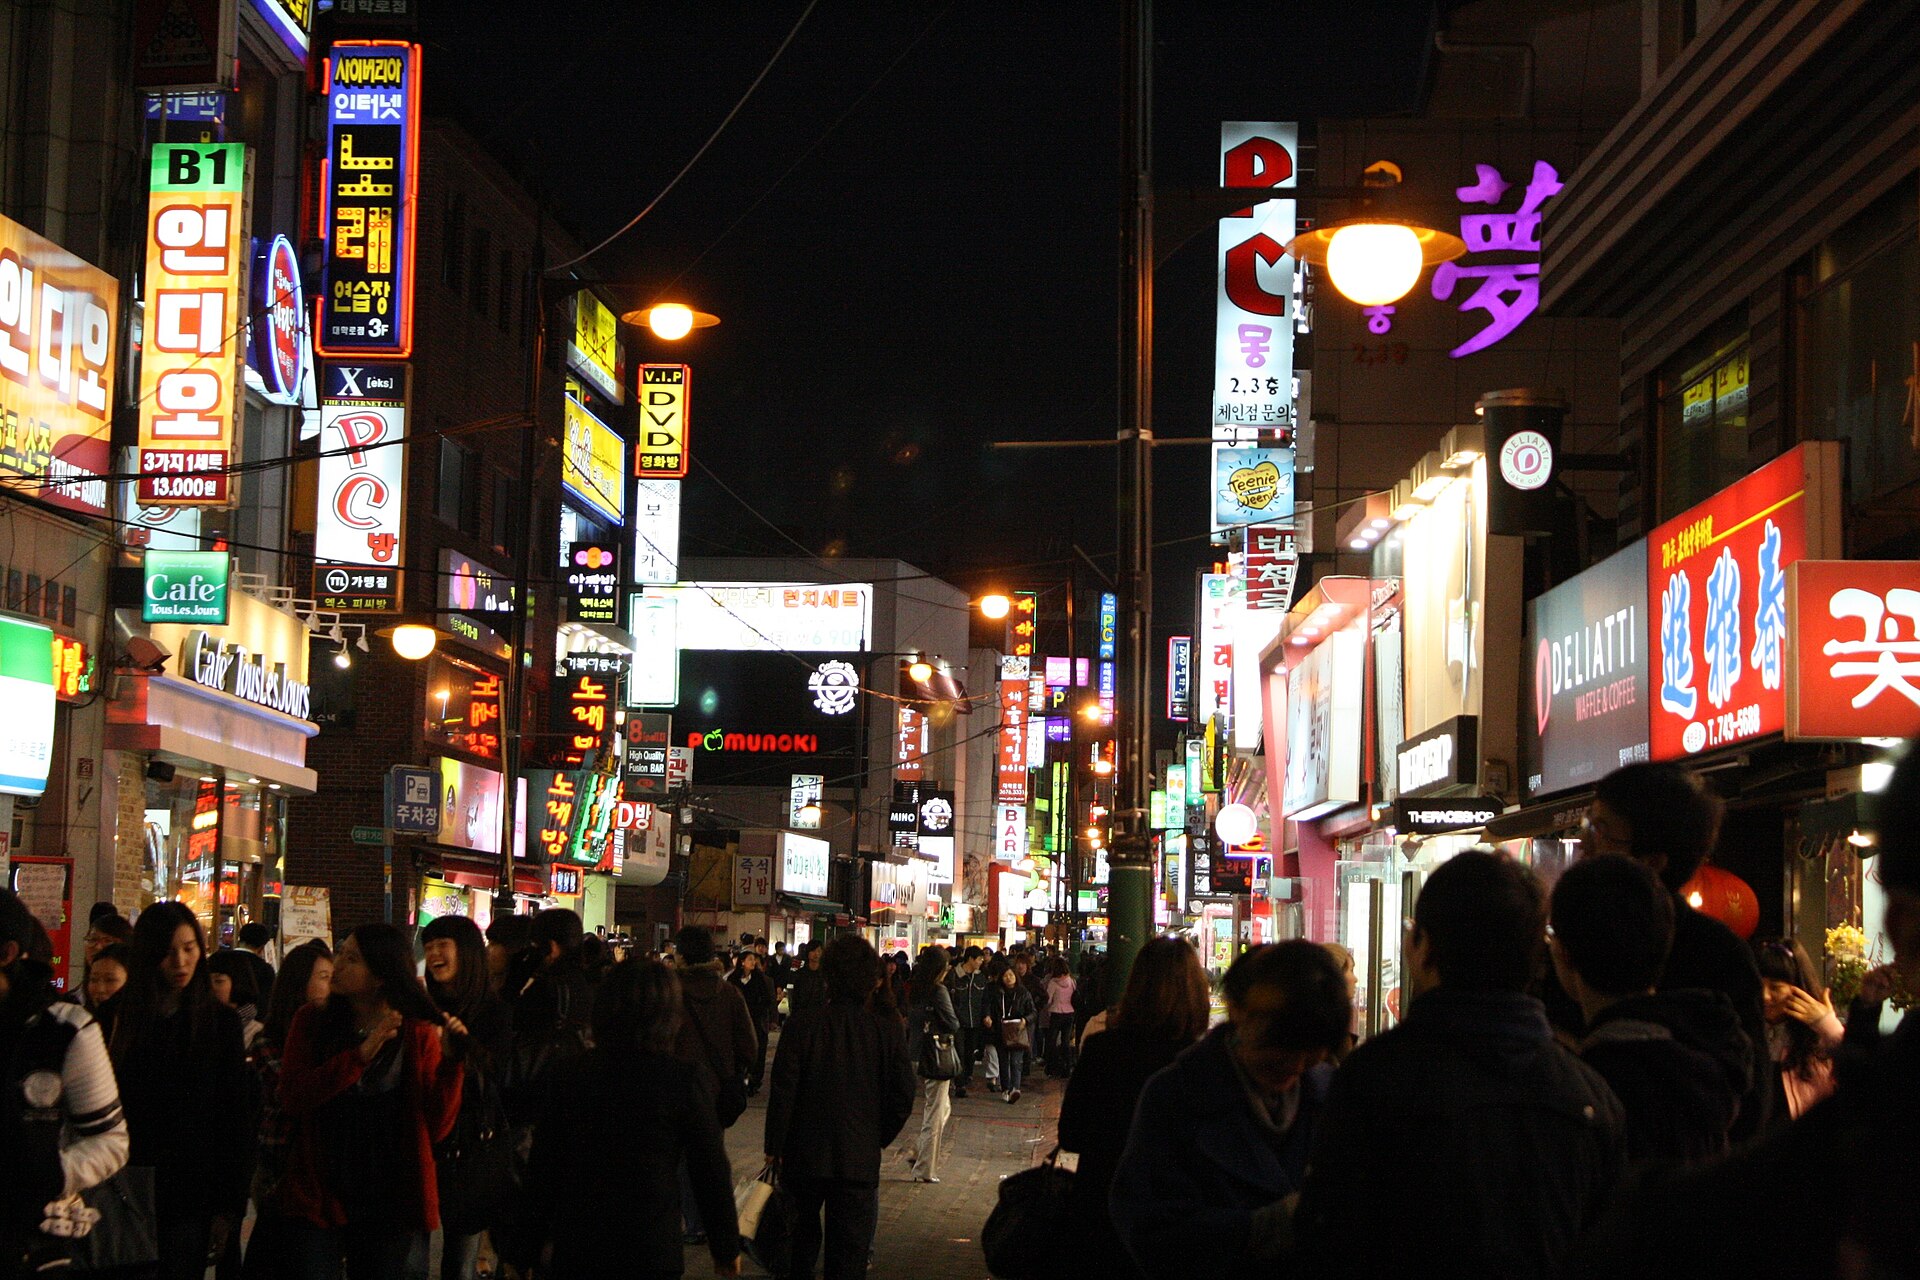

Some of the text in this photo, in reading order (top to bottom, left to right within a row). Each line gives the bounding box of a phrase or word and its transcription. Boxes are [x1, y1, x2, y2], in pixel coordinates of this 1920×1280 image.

[335, 93, 401, 119] 인터넷
[168, 148, 227, 185] B1
[336, 134, 393, 273] 노래
[1223, 136, 1293, 316] PC
[1431, 160, 1566, 358] 夢
[334, 281, 391, 314] 연습장
[149, 206, 232, 440] 인디오
[332, 318, 389, 337] 대학로점 3F
[1237, 323, 1273, 368] 몽
[337, 367, 364, 396] X
[645, 370, 681, 382] V.I.P
[647, 391, 675, 446] DVD
[1217, 402, 1291, 423] 체인점 문의
[1505, 435, 1549, 459] DELIATTI
[144, 453, 223, 474] 3가지 1세트
[327, 411, 389, 530] PC
[641, 457, 679, 468] 영화방
[152, 478, 217, 496] 13.000원
[1228, 472, 1276, 492] Teenie
[1237, 490, 1279, 507] Weenie
[367, 533, 398, 562] 방
[146, 573, 226, 602] Café
[783, 590, 859, 608] 런치세트
[1101, 613, 1115, 643] PC
[1552, 605, 1634, 695] DELIATTI
[1823, 588, 1920, 709] 꽃
[1576, 688, 1601, 721] WAFFLE
[1608, 675, 1635, 710] COFFEE
[688, 729, 817, 752] POMUNOKI
[628, 763, 665, 773] Fusion BAR
[629, 750, 665, 762] High Quality
[407, 777, 416, 794] P
[397, 805, 437, 825] 주차장
[540, 772, 576, 856] 노래방
[1004, 809, 1018, 852] BAR
[740, 857, 769, 874] 즉석
[740, 877, 769, 897] 김밥
